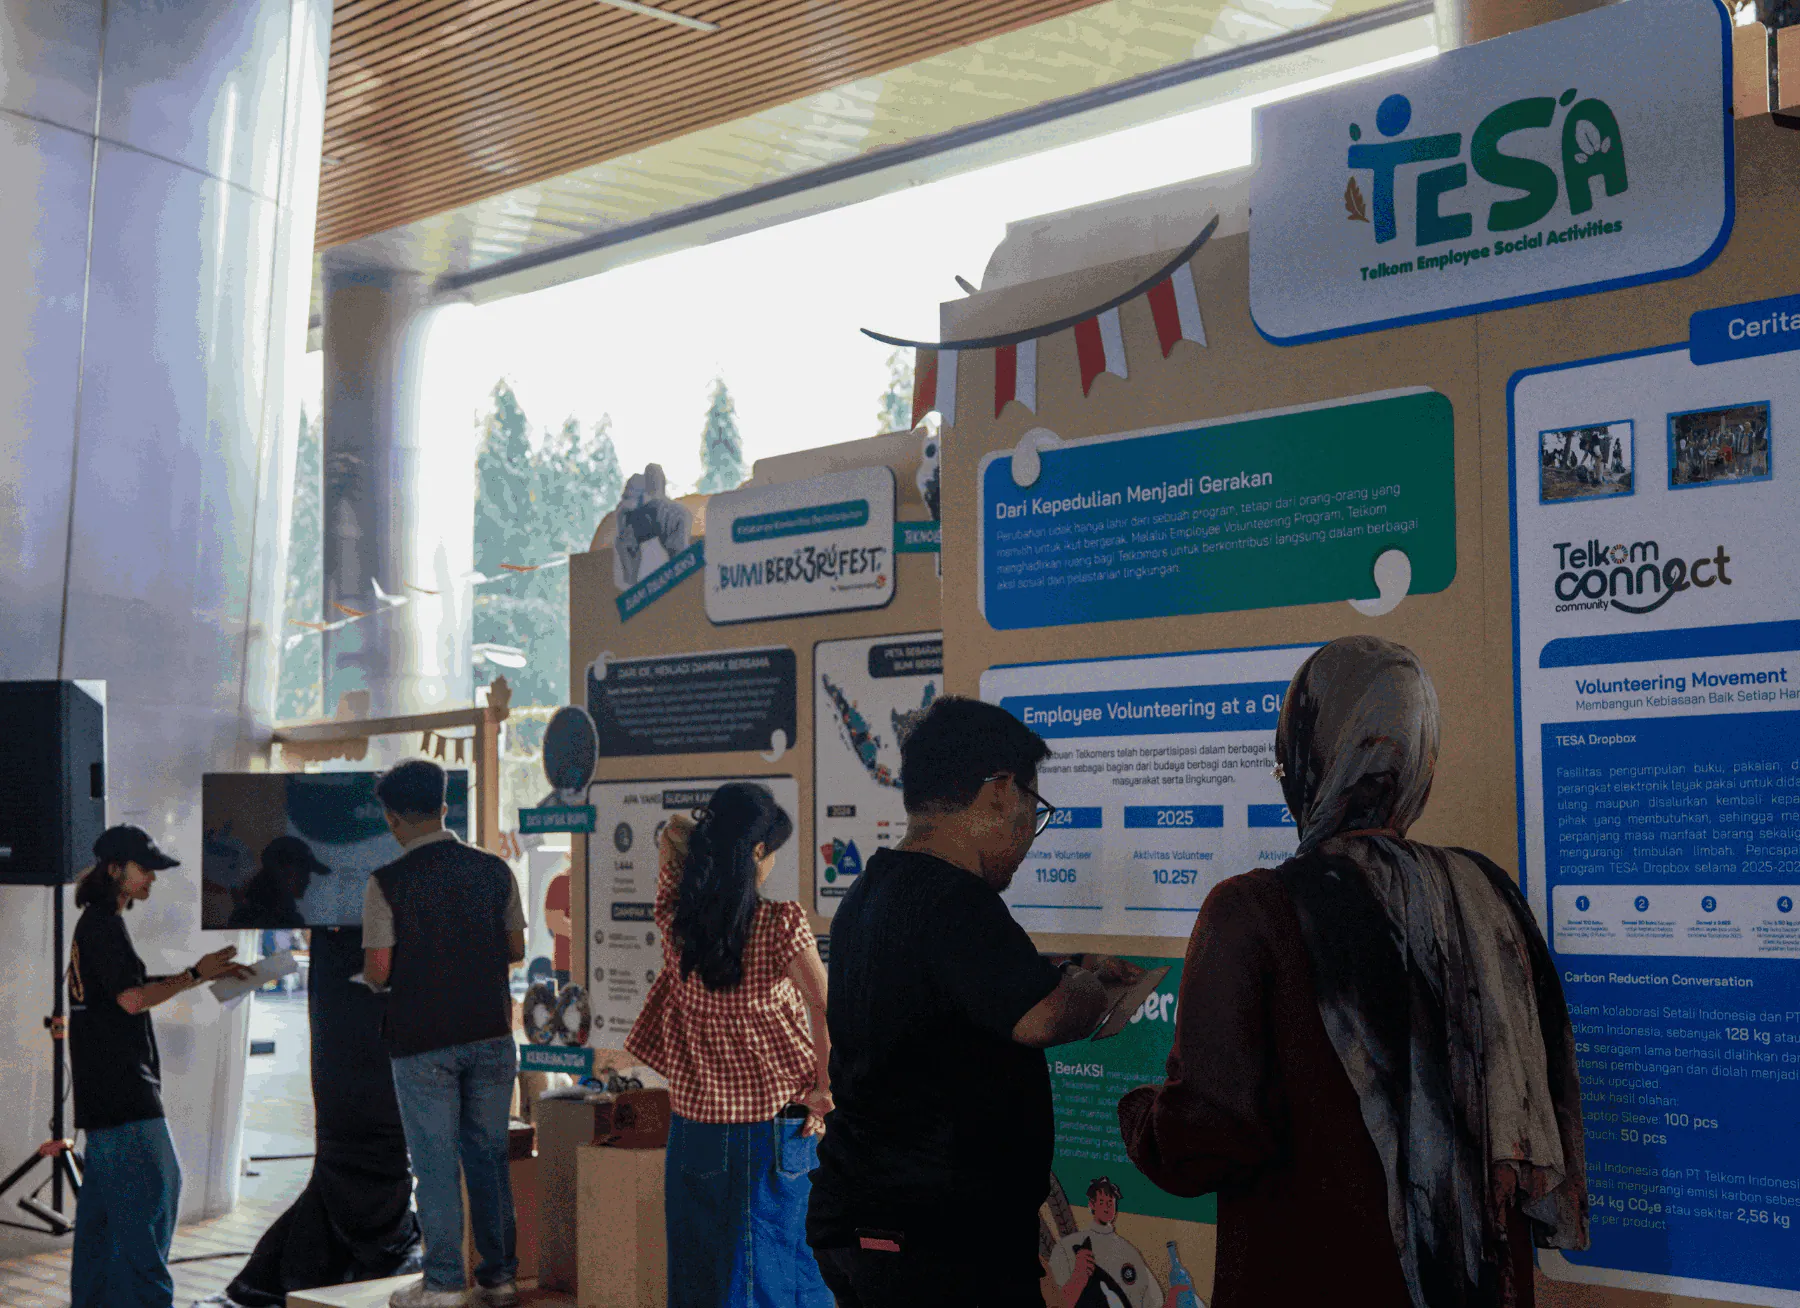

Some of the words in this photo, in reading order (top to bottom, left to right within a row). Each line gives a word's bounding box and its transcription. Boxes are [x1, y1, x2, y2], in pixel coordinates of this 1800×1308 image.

[1348, 94, 1628, 246] TESA
[1360, 257, 1414, 281] Telkom
[1417, 243, 1490, 272] Employee
[1494, 231, 1543, 256] Social
[1546, 219, 1623, 246] Activities
[1728, 310, 1800, 341] Cerita
[996, 501, 1027, 519] Dari
[1032, 490, 1122, 517] Kepedulian
[1127, 478, 1194, 503] Menjadi
[1199, 471, 1273, 494] Gerakan
[1073, 521, 1104, 533] hanya
[1106, 516, 1128, 529] lahir
[1131, 514, 1150, 526] dari
[1152, 509, 1189, 524] sebuah
[1241, 499, 1272, 513] tetapi
[1275, 497, 1296, 509] dari
[1299, 488, 1368, 506] orang-orang
[1372, 484, 1401, 500] yang
[1131, 529, 1168, 544] Melalui
[1170, 522, 1220, 540] Employee
[1224, 515, 1291, 534] Volunteering
[1347, 504, 1387, 520] Telkom
[1094, 550, 1114, 567] bagi
[1119, 545, 1168, 562] Telkomers
[1170, 541, 1200, 556] untuk
[1203, 533, 1272, 553] berkontribusi
[1275, 526, 1325, 545] langsung
[1329, 522, 1364, 538] dalam
[1367, 517, 1419, 535] berbagai
[1553, 540, 1659, 570] Telkom
[720, 560, 763, 588] BUMI
[1067, 567, 1121, 585] pelestarian
[1555, 545, 1732, 614] connect
[1555, 599, 1609, 613] community
[1576, 674, 1686, 695] Volunteering
[1692, 667, 1787, 687] Movement
[1576, 697, 1643, 711] Membangun
[1646, 693, 1706, 707] Kebiasaan
[1709, 690, 1734, 704] Baik
[1737, 688, 1776, 705] Setiap
[1023, 704, 1102, 727] Employee
[1106, 698, 1216, 721] Volunteering
[1221, 697, 1240, 713] at
[1246, 700, 1256, 713] a
[1556, 735, 1585, 746] TESA
[1588, 733, 1636, 746] Dropbox
[1076, 748, 1115, 760] Telkomers
[1117, 747, 1138, 759] telah
[1199, 744, 1226, 757] dalam
[1228, 743, 1266, 757] berbagai
[1074, 763, 1105, 775] sebagai
[1107, 761, 1135, 775] bagian
[1137, 760, 1151, 772] dari
[1153, 759, 1185, 775] budaya
[1187, 758, 1220, 774] berbagi
[1222, 757, 1239, 770] dan
[1557, 766, 1602, 778] Fasilitas
[1609, 763, 1686, 778] pengumpulan
[1694, 762, 1725, 775] buku,
[1733, 760, 1783, 773] pakaian,
[1112, 774, 1161, 788] masyarakat
[1163, 773, 1184, 785] serta
[1557, 782, 1611, 796] perangkat
[1613, 780, 1669, 793] elektronik
[1671, 779, 1702, 793] layak
[1705, 778, 1737, 791] pakai
[1739, 777, 1773, 789] untuk
[1558, 799, 1588, 812] ulang
[1595, 798, 1640, 811] maupun
[1649, 796, 1708, 808] disalurkan
[1716, 793, 1762, 806] kembali
[1157, 810, 1193, 825] 2025
[1558, 814, 1588, 828] pihak
[1594, 815, 1621, 828] yang
[1628, 811, 1712, 825] membutuhkan,
[1719, 810, 1773, 824] sehingga
[1559, 829, 1620, 844] perpanjang
[1624, 831, 1655, 842] masa
[1659, 828, 1707, 841] manfaat
[1712, 827, 1754, 842] barang
[1054, 851, 1091, 861] Volunteer
[1133, 851, 1169, 861] Aktivitas
[1172, 851, 1213, 862] Volunteer
[1559, 846, 1623, 860] mengurangi
[1633, 845, 1683, 857] timbulan
[1036, 868, 1077, 883] 11.906
[1153, 868, 1198, 884] 10.257
[1560, 862, 1605, 877] program
[1609, 862, 1638, 874] TESA
[1644, 861, 1690, 876] Dropbox
[1694, 860, 1737, 873] selama
[1638, 899, 1645, 909] 2
[1705, 899, 1713, 909] 3
[1781, 899, 1789, 909] 4
[1565, 971, 1606, 984] Carbon
[1609, 972, 1669, 985] Reduction
[1672, 974, 1754, 988] Conversation
[1602, 1005, 1660, 1018] kolaborasi
[1663, 1006, 1696, 1020] Setali
[1699, 1008, 1756, 1022] Indonesia
[1760, 1010, 1782, 1023] dan
[1666, 1025, 1722, 1041] sebanyak
[1725, 1027, 1750, 1041] 128
[1754, 1028, 1771, 1045] kg
[1774, 1032, 1800, 1044] atau
[1594, 1044, 1641, 1057] seragam
[1644, 1044, 1672, 1057] lama
[1675, 1046, 1721, 1060] berhasil
[1724, 1048, 1779, 1063] dialihkan
[1055, 1061, 1104, 1077] BerAKSI
[1610, 1060, 1684, 1076] pembuangan
[1686, 1063, 1709, 1076] dan
[1712, 1064, 1748, 1078] diolah
[1751, 1069, 1799, 1083] menjadi
[1609, 1091, 1636, 1104] hasil
[1664, 1112, 1689, 1127] 100
[1693, 1116, 1719, 1131] pcs
[1620, 1129, 1639, 1143] 50
[1643, 1133, 1668, 1146] pcs
[1604, 1163, 1659, 1177] Indonesia
[1661, 1168, 1683, 1180] dan
[1686, 1169, 1701, 1181] PT
[1704, 1170, 1746, 1185] Telkom
[1617, 1180, 1684, 1198] mengurangi
[1687, 1187, 1719, 1199] emisi
[1721, 1190, 1763, 1204] karbon
[1608, 1195, 1625, 1212] kg
[1665, 1203, 1691, 1216] atau
[1694, 1205, 1734, 1220] sekitar
[1737, 1208, 1769, 1224] 2,56
[1773, 1211, 1791, 1229] kg
[1602, 1214, 1621, 1226] per
[1623, 1217, 1667, 1230] product
